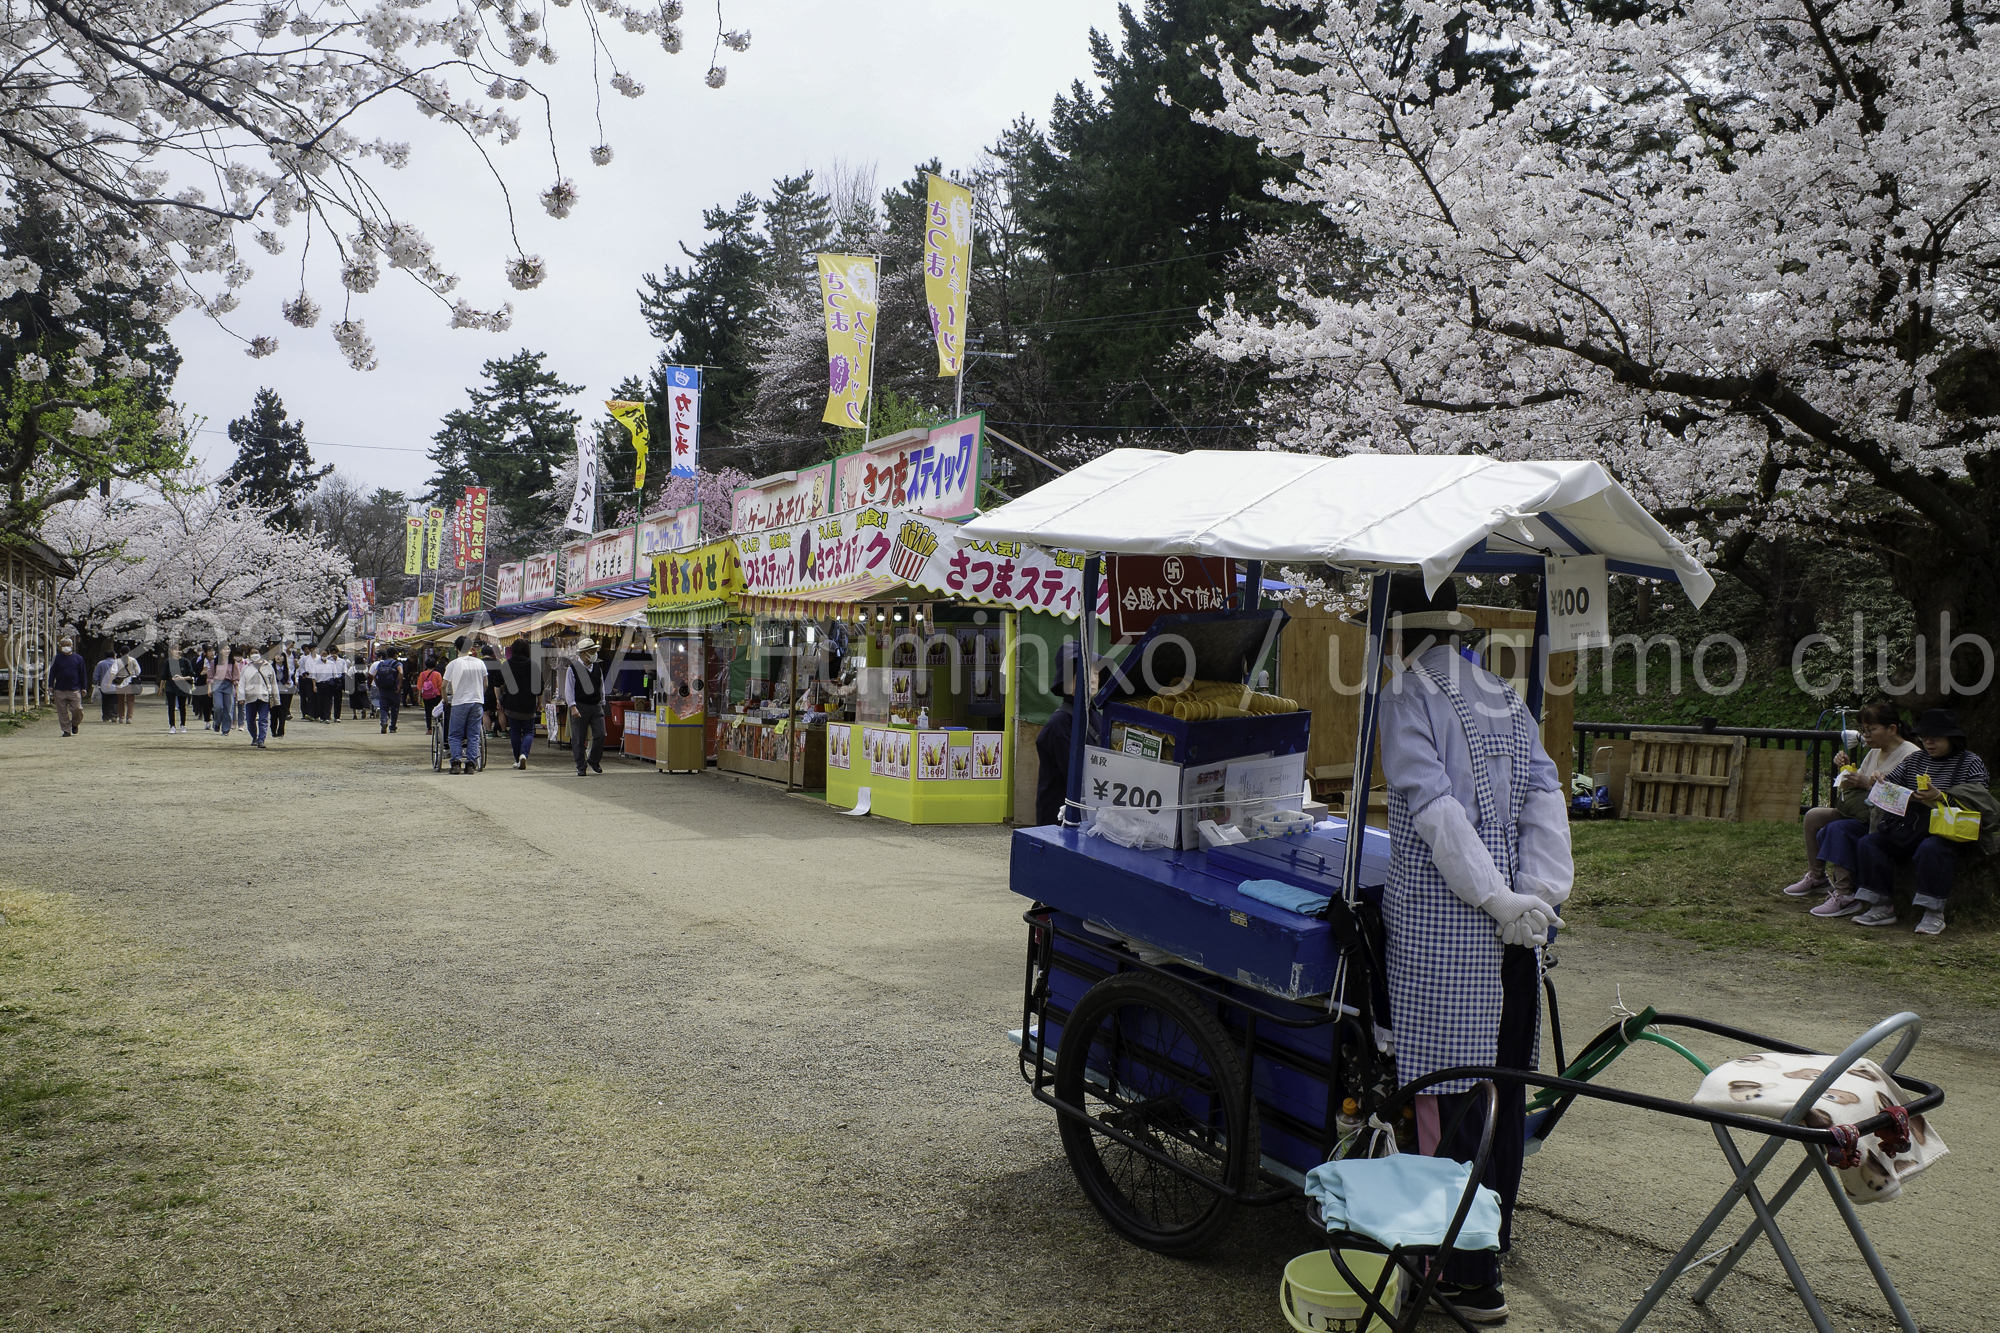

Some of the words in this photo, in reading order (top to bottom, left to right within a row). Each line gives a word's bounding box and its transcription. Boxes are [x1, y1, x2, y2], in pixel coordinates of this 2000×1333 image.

[860, 433, 974, 508] さつまスティック
[748, 492, 808, 531] ゲームあそび
[946, 549, 1109, 616] さつまスティク
[1550, 586, 1590, 618] ¥200
[1090, 754, 1107, 767] 値段
[1093, 778, 1162, 814] ¥200
